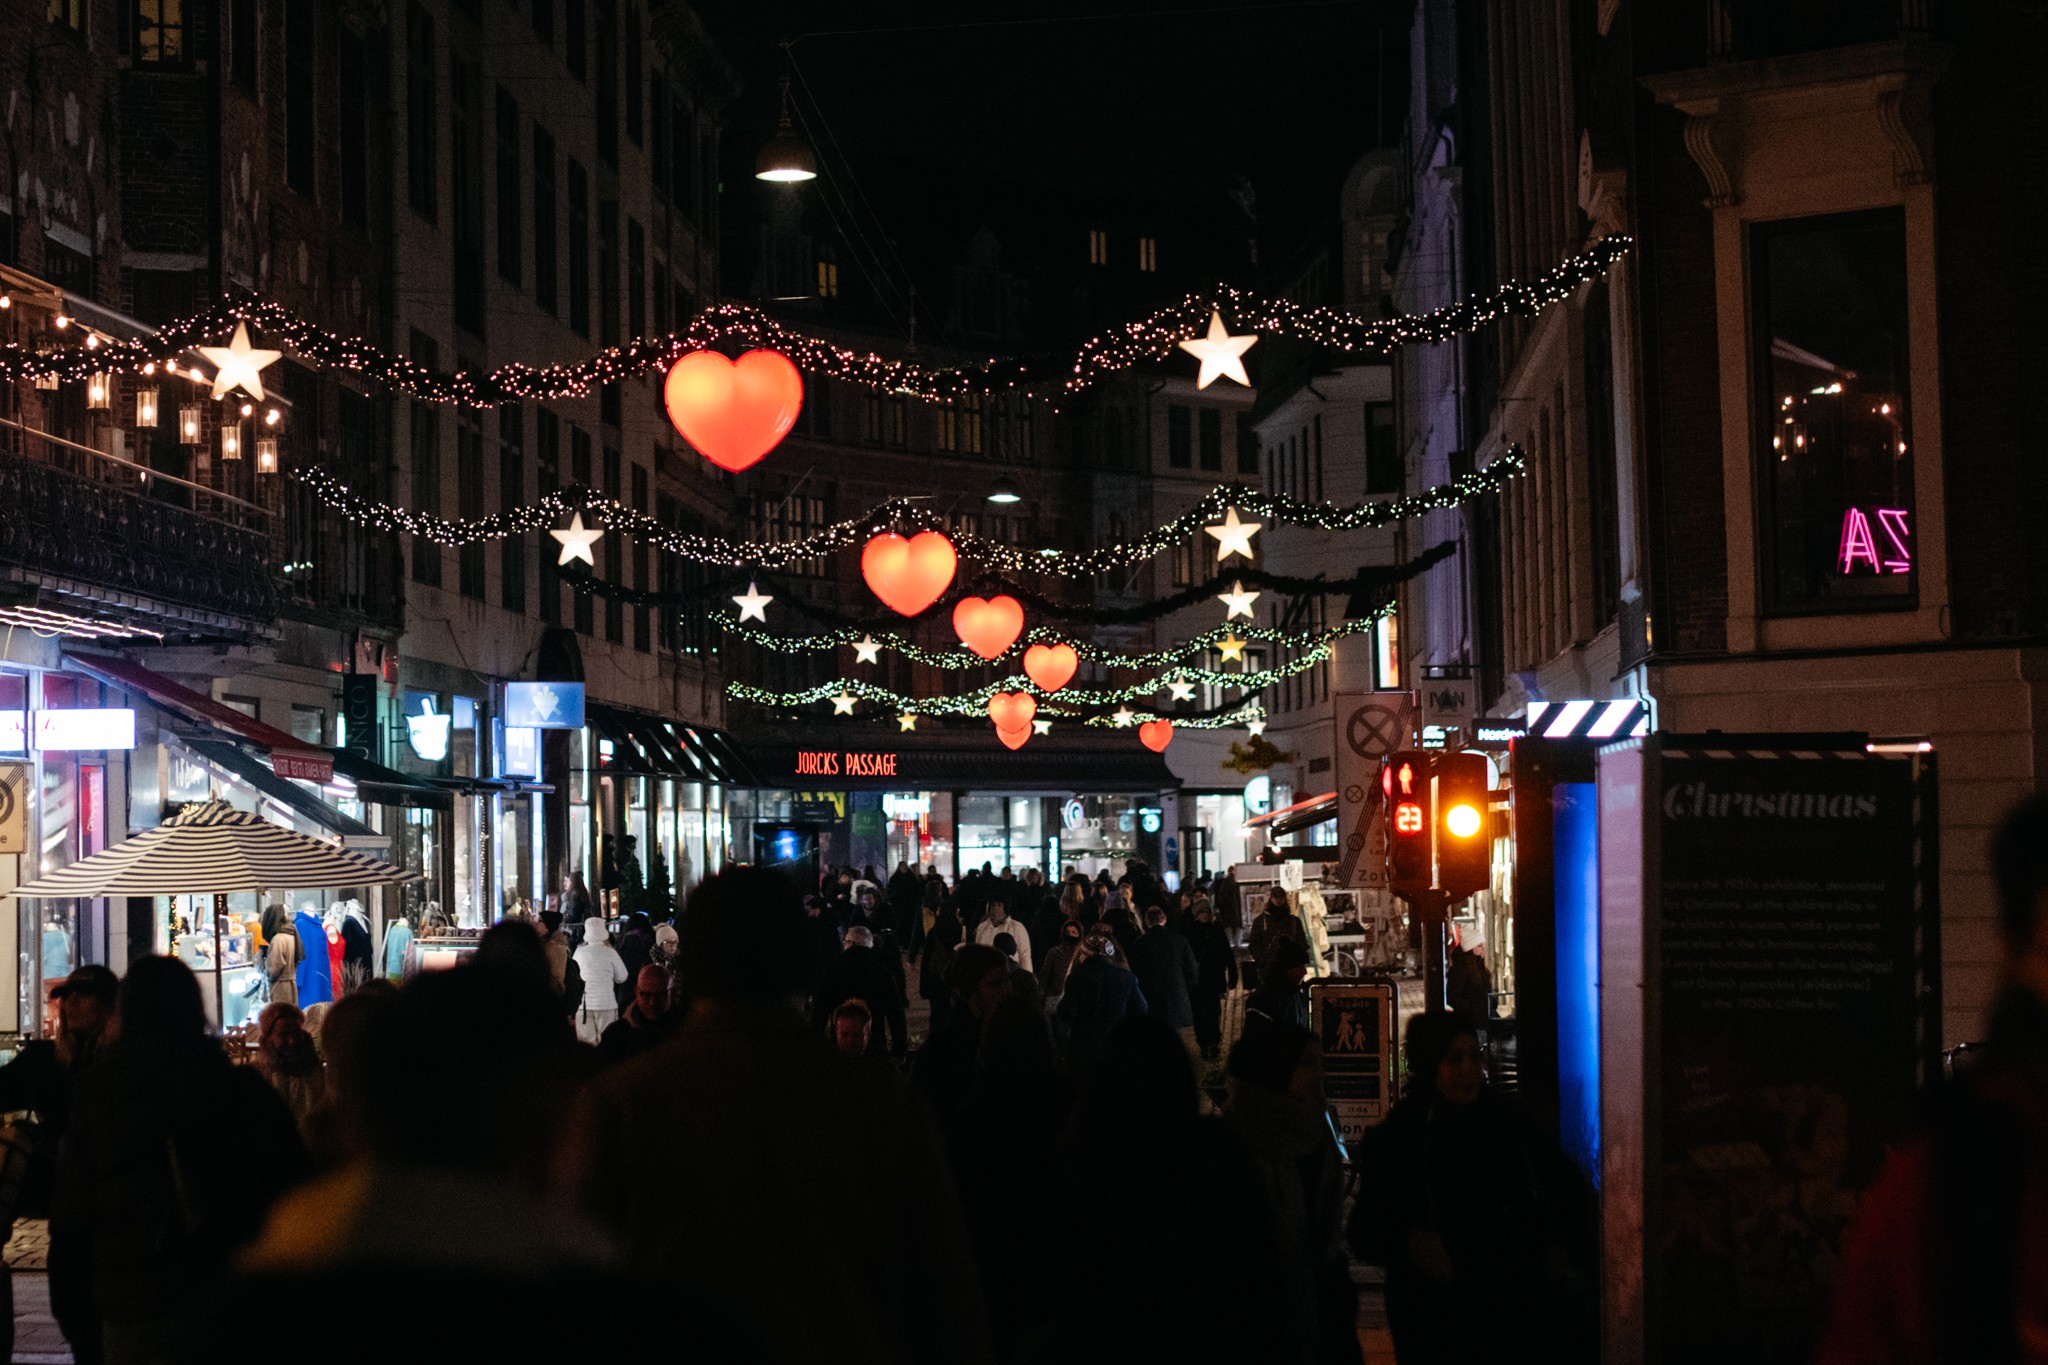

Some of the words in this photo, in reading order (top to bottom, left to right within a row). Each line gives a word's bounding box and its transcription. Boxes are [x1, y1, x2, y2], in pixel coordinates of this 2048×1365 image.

[795, 751, 840, 775] JORCKS
[845, 752, 898, 776] PASSAGE
[1662, 781, 1878, 821] Christmas
[1399, 806, 1423, 832] 23
